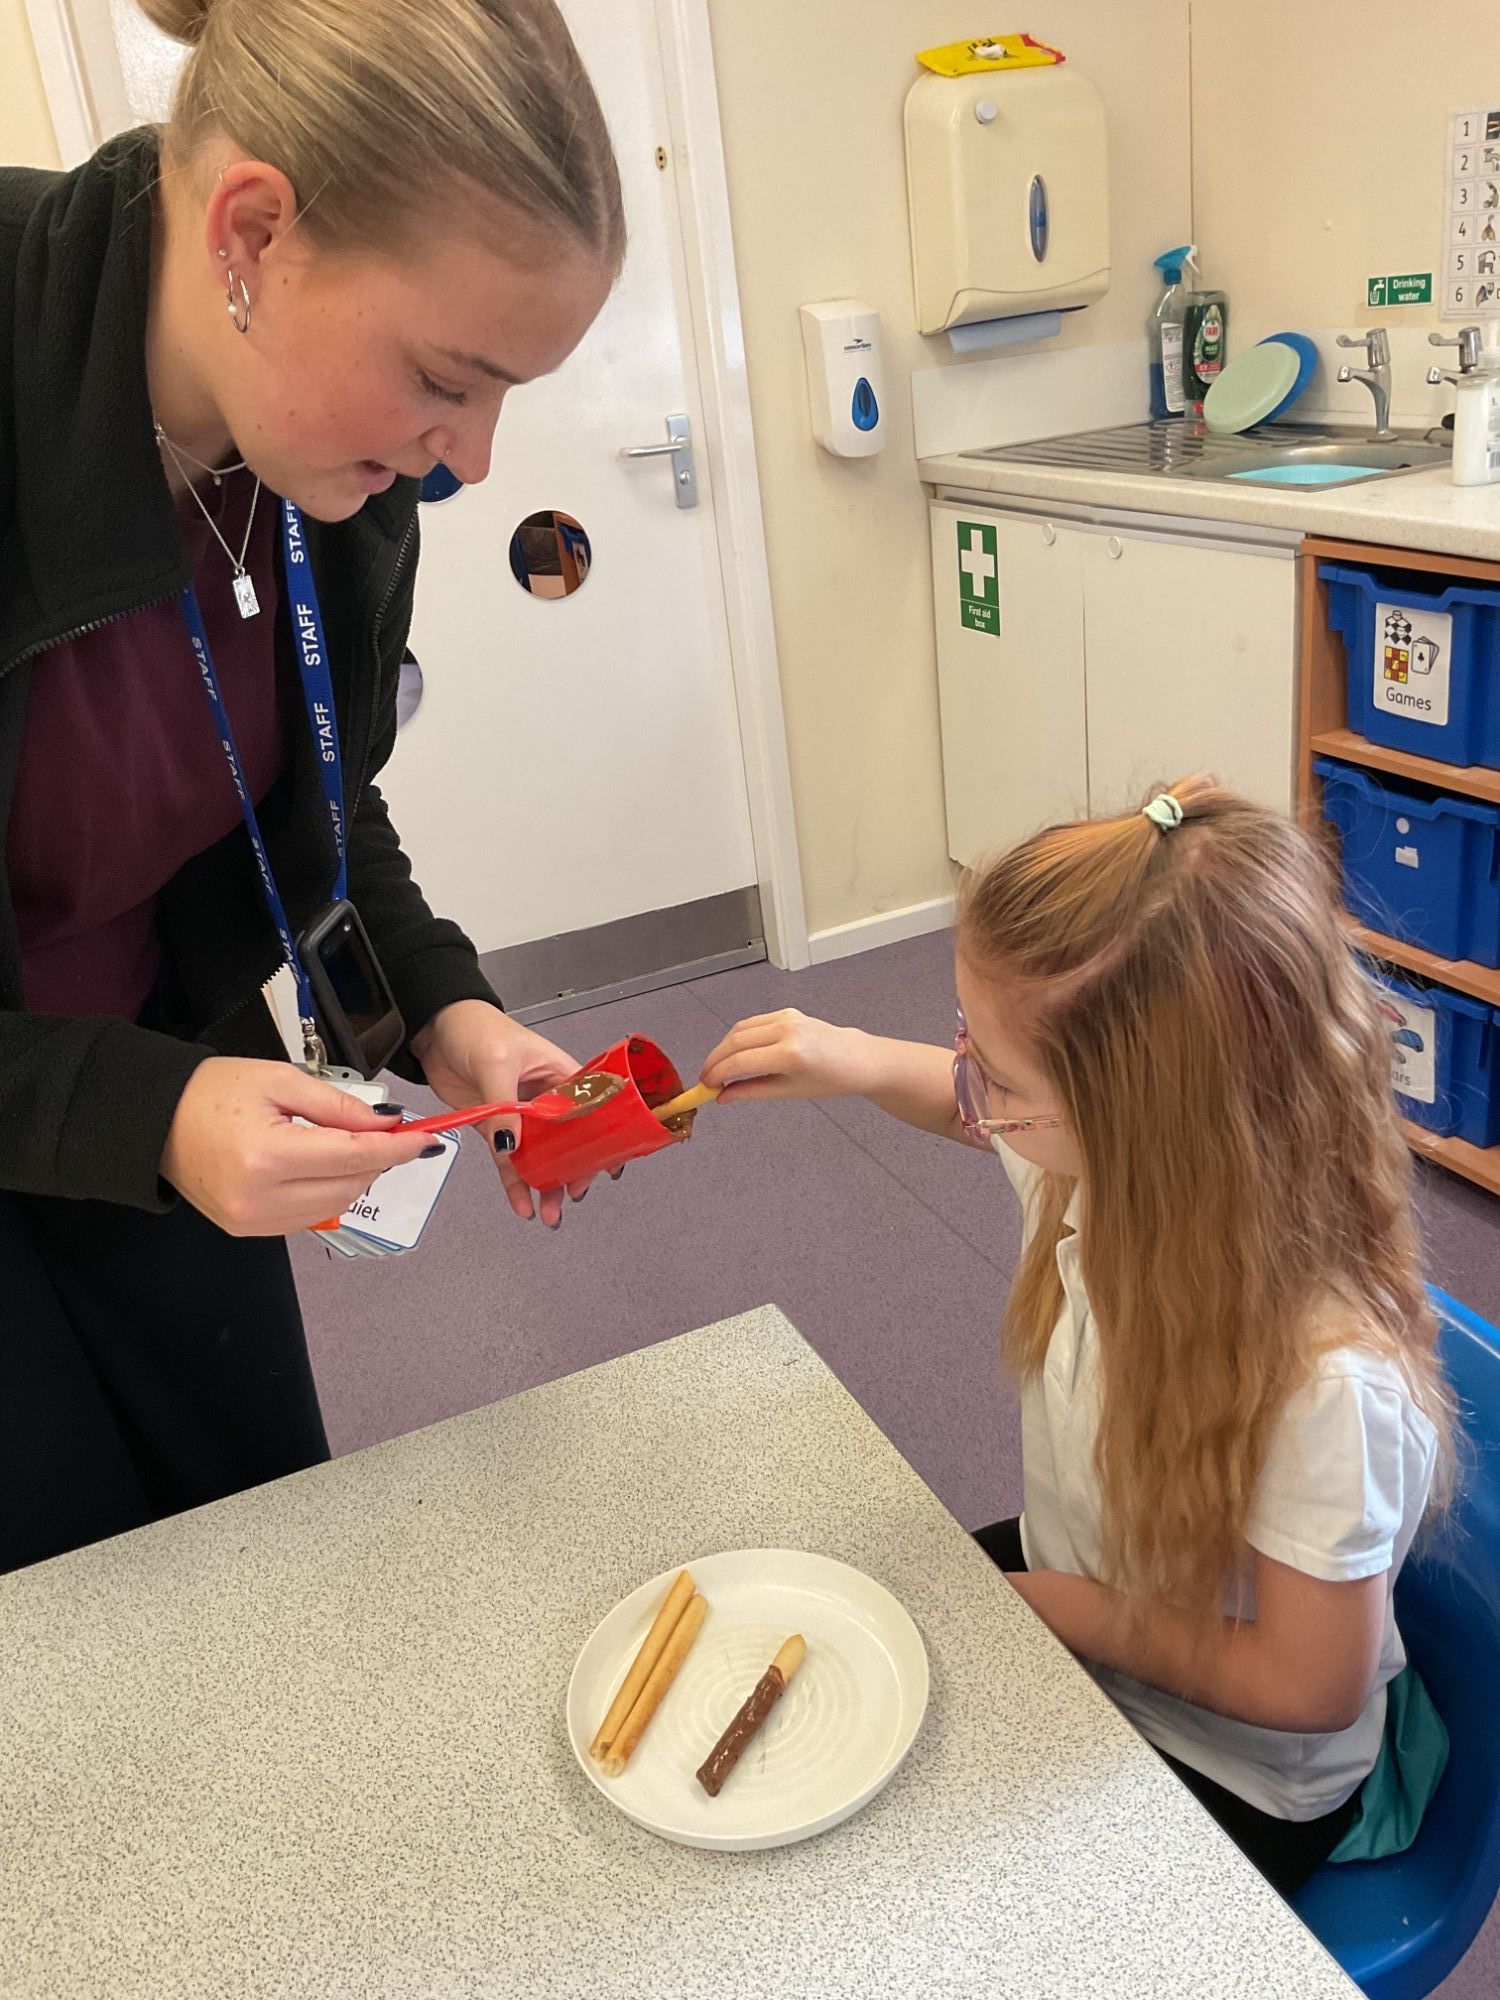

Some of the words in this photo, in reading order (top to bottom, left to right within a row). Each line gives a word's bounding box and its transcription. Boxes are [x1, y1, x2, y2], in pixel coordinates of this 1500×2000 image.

[1463, 121, 1469, 137] 1
[1461, 155, 1468, 171] 2
[1460, 188, 1467, 205] 3
[1458, 221, 1466, 237] 4
[1457, 254, 1464, 270] 5
[1392, 277, 1426, 290] Drinking
[1398, 291, 1420, 302] water
[1455, 287, 1463, 302] 6
[286, 498, 305, 563] STAFF
[968, 605, 981, 616] First
[982, 608, 991, 618] aid
[974, 617, 986, 629] box
[296, 603, 321, 666] STAFF
[192, 636, 218, 701] STAFF
[1386, 686, 1432, 711] Games
[313, 701, 336, 762] STAFF
[222, 739, 246, 801] STAFF
[1391, 1070, 1411, 1087] ars
[346, 1199, 381, 1221] uiet
